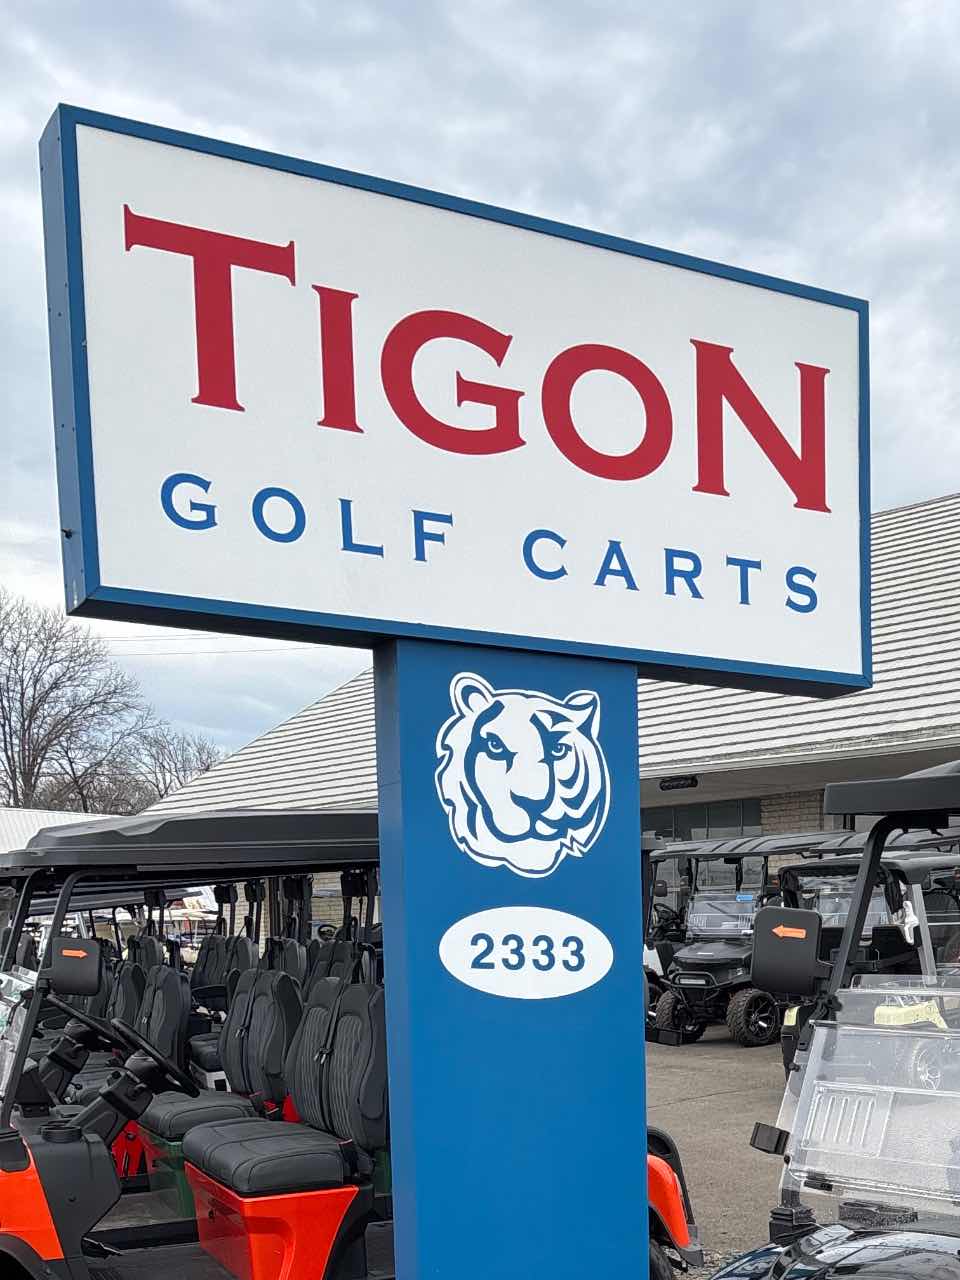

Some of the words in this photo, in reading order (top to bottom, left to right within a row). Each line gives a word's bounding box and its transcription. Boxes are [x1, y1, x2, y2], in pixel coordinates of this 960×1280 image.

[124, 204, 832, 513] TIGON
[160, 473, 454, 561] GOLF
[522, 529, 819, 613] CARTS
[470, 933, 586, 973] 2333
